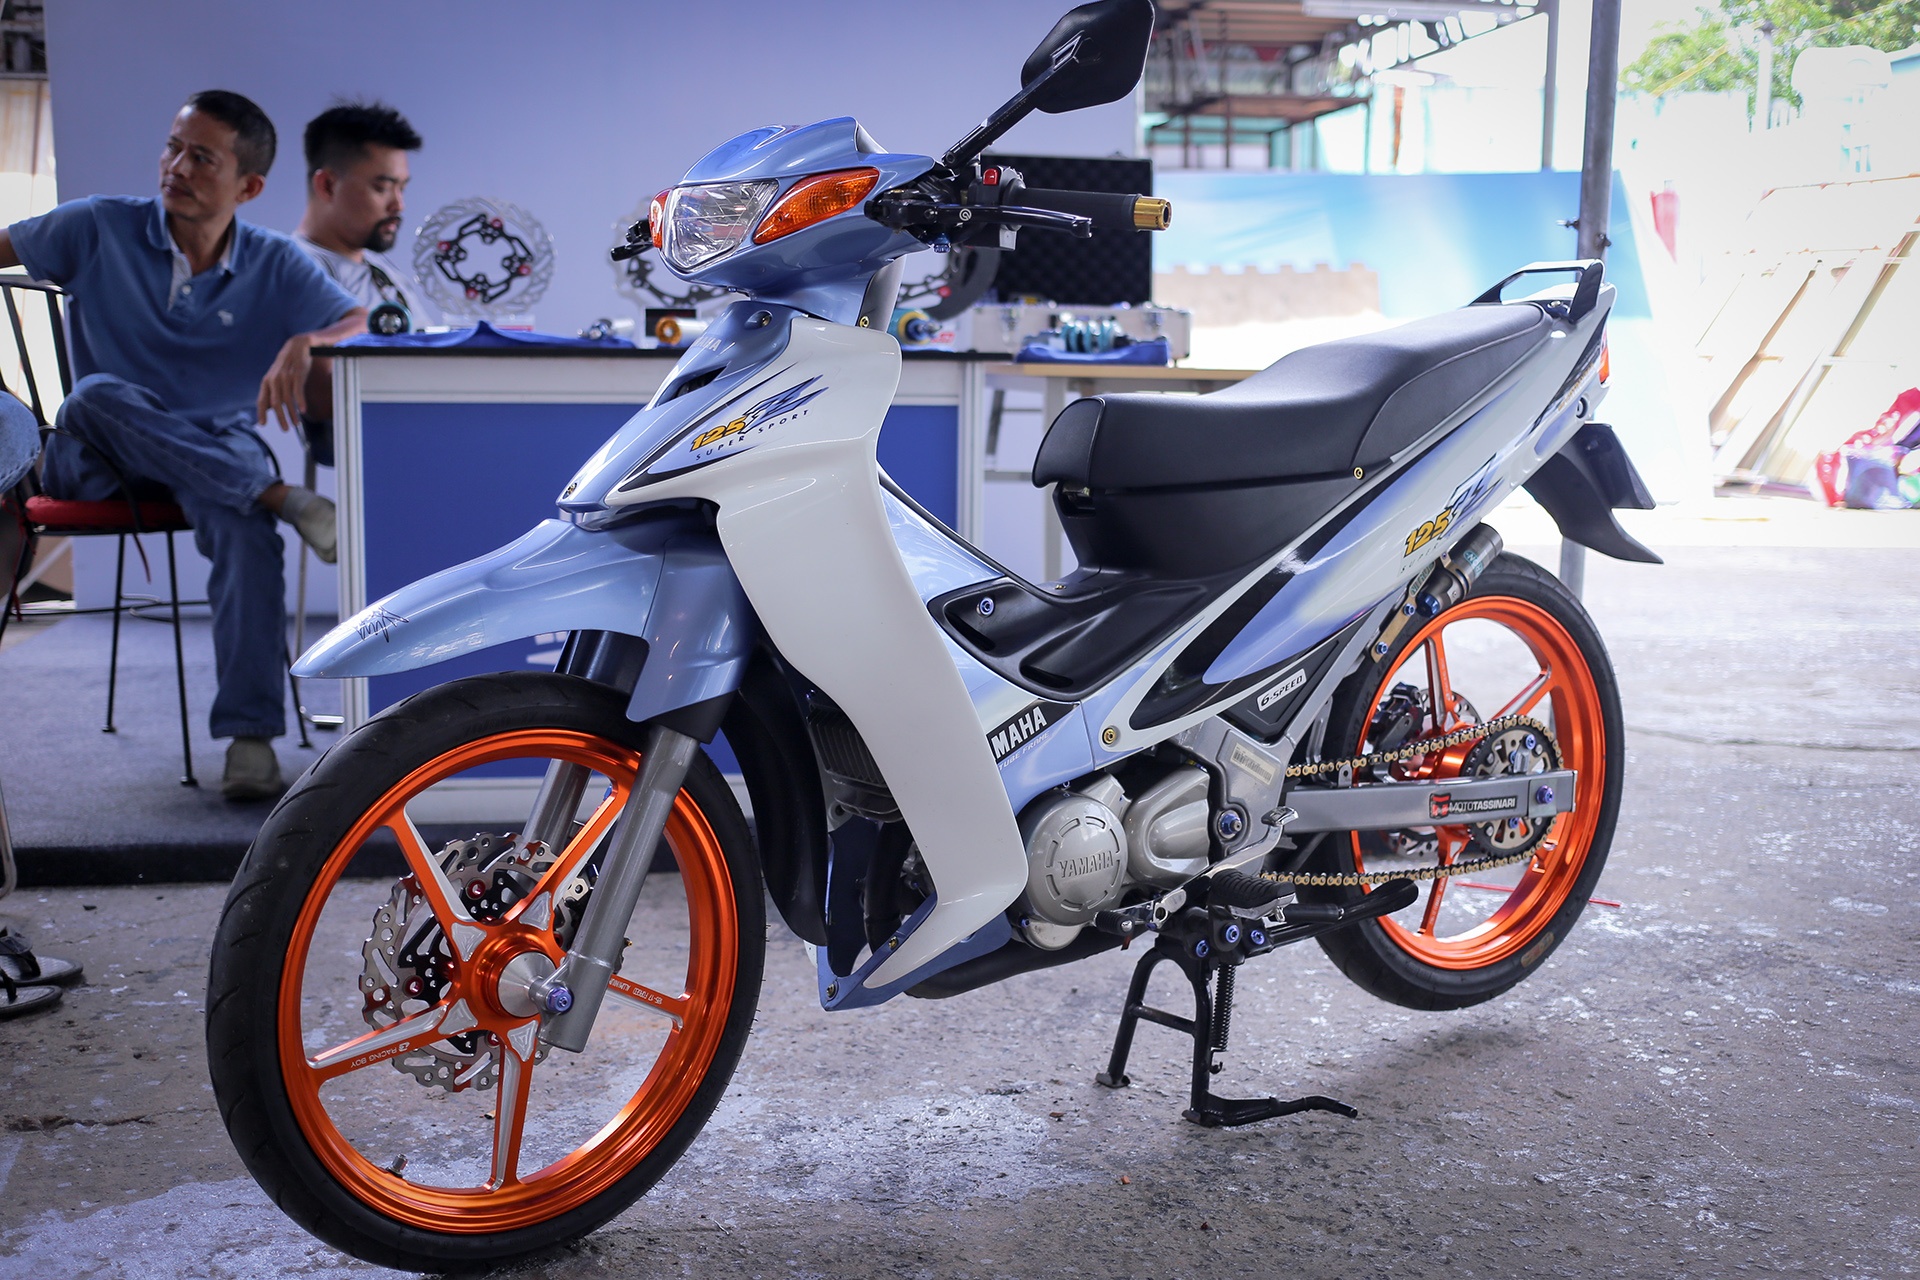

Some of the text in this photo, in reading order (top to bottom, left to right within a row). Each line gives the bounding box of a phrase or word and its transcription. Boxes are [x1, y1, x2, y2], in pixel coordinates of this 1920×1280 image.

[696, 409, 809, 460] SUPER SPORT
[1260, 675, 1303, 706] 6-SPEED
[998, 732, 1050, 771] TUBE FRAME
[1058, 850, 1114, 878] YAMAHA
[351, 1047, 398, 1068] RACING BOY
